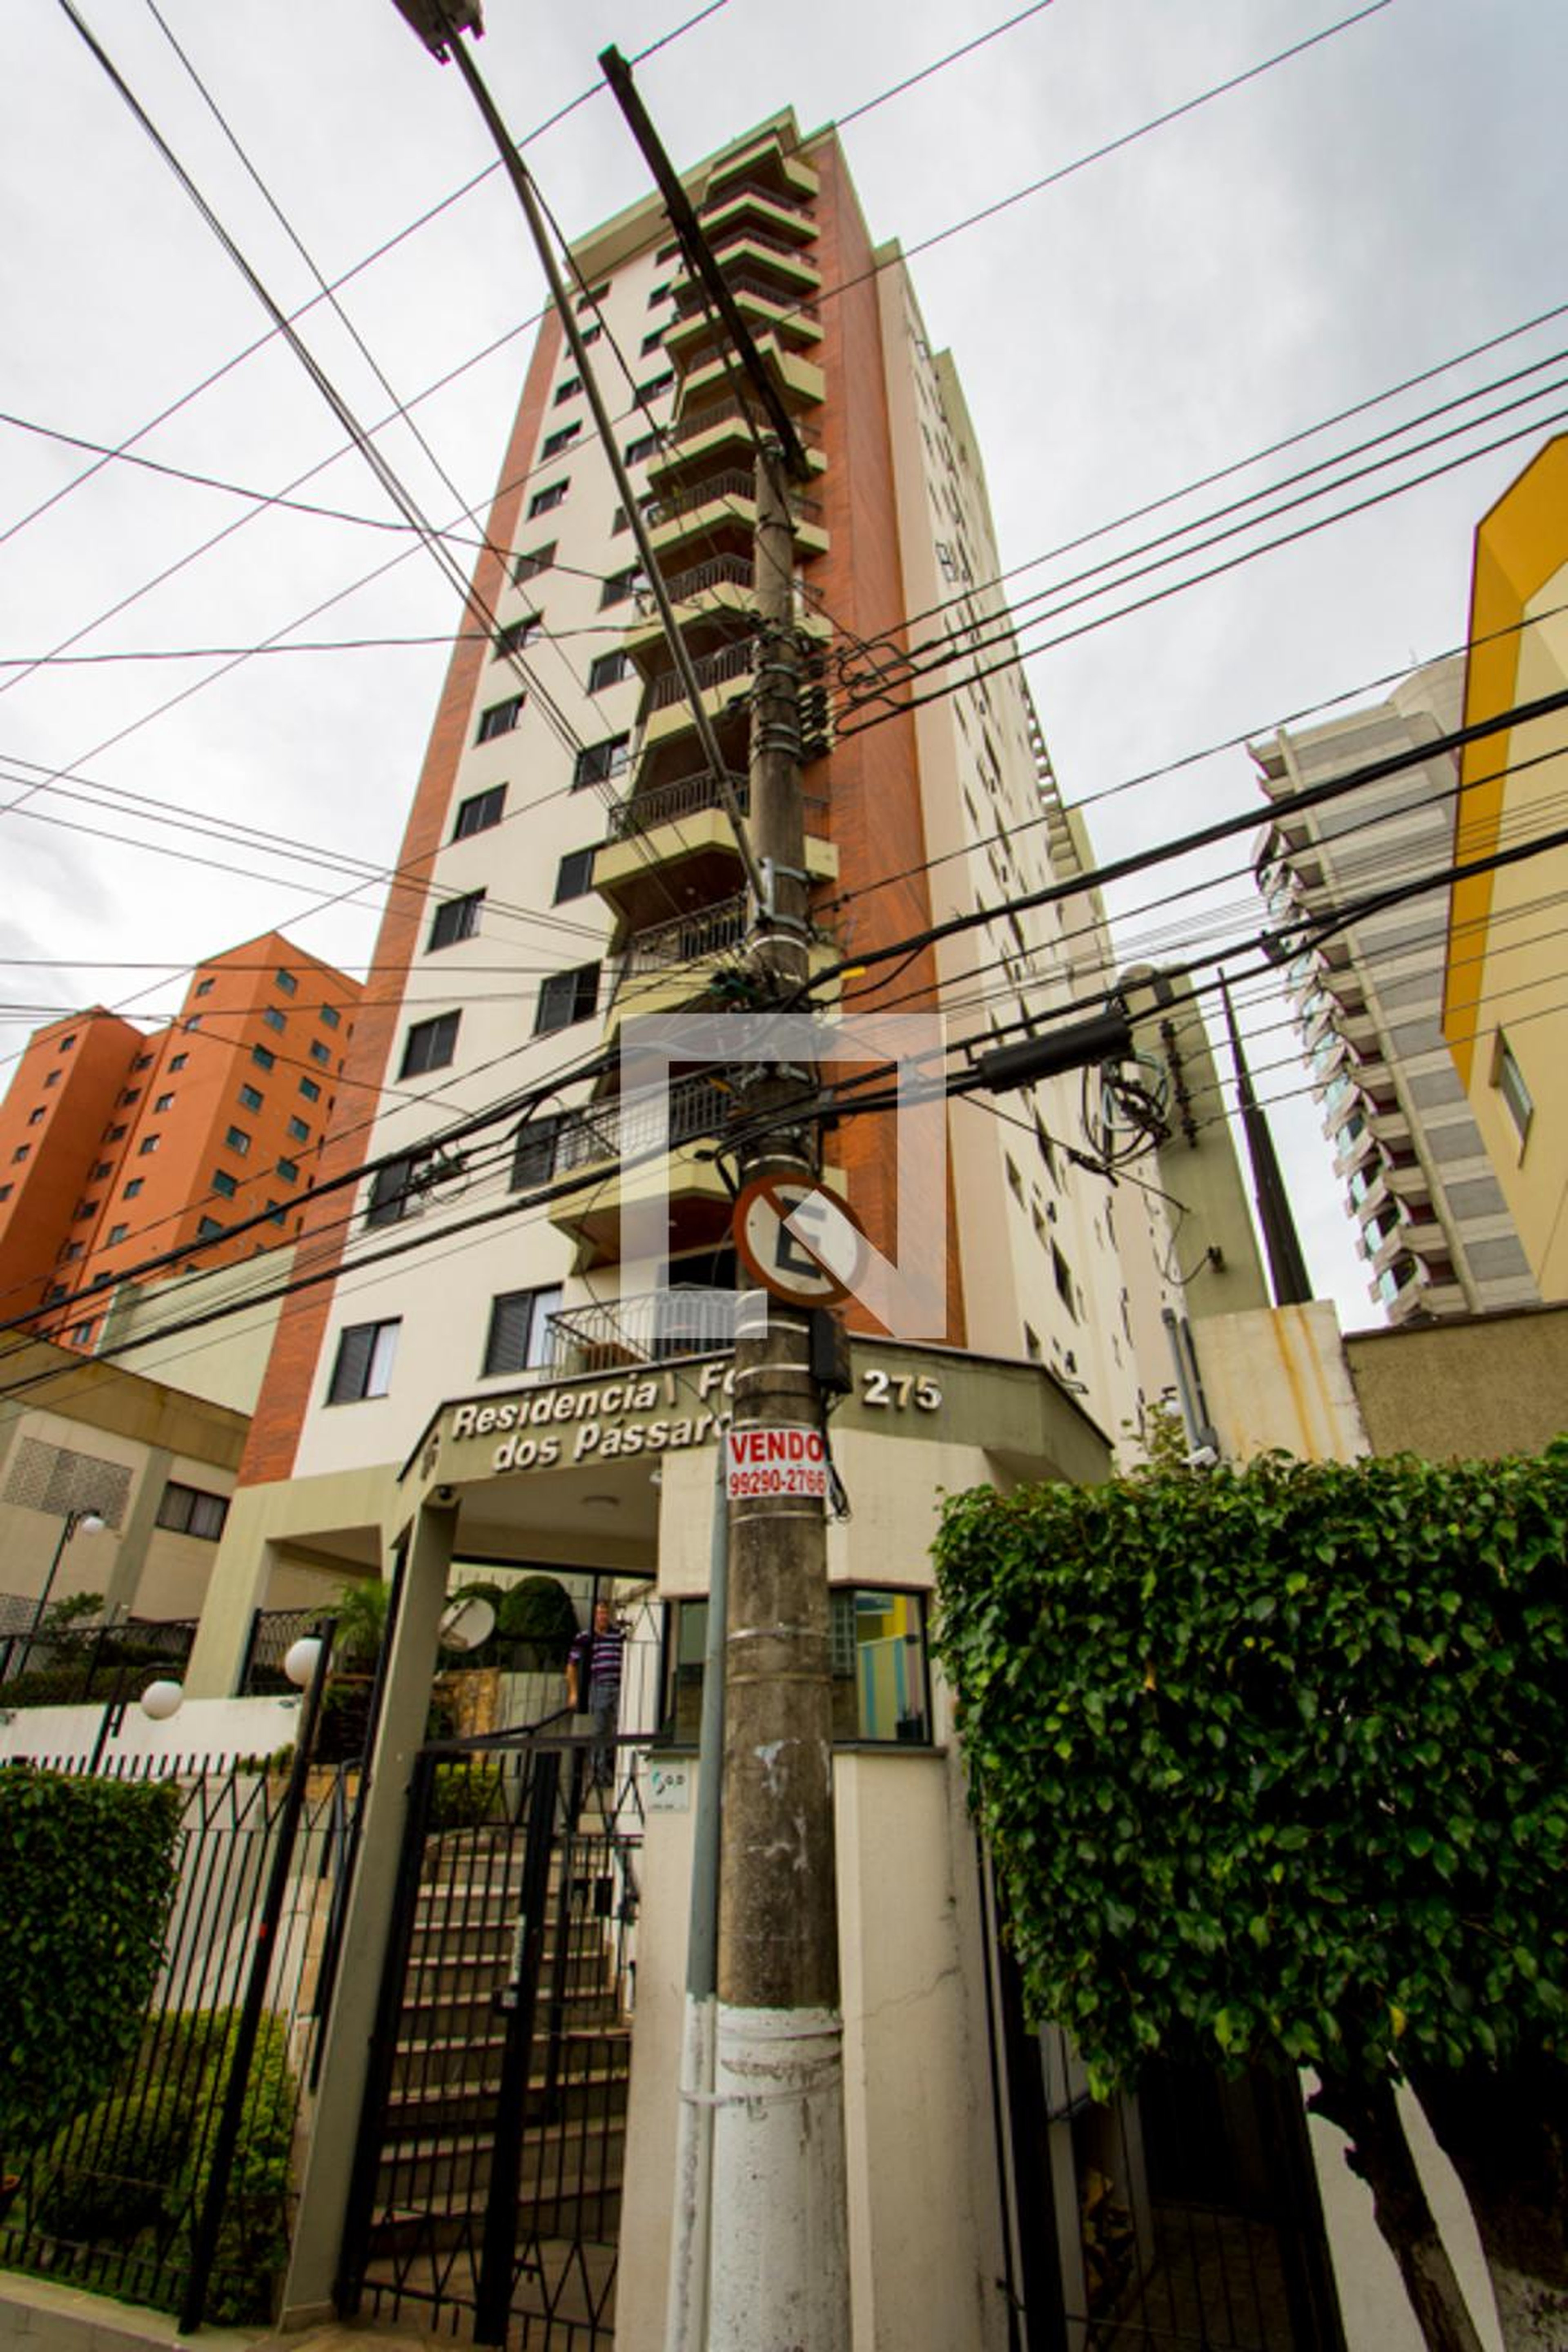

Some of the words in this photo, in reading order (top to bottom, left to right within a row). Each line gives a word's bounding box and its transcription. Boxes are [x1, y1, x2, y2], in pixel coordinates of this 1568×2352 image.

[863, 1370, 942, 1410] 275
[493, 1434, 560, 1472] dos
[730, 1431, 824, 1464] VENDO
